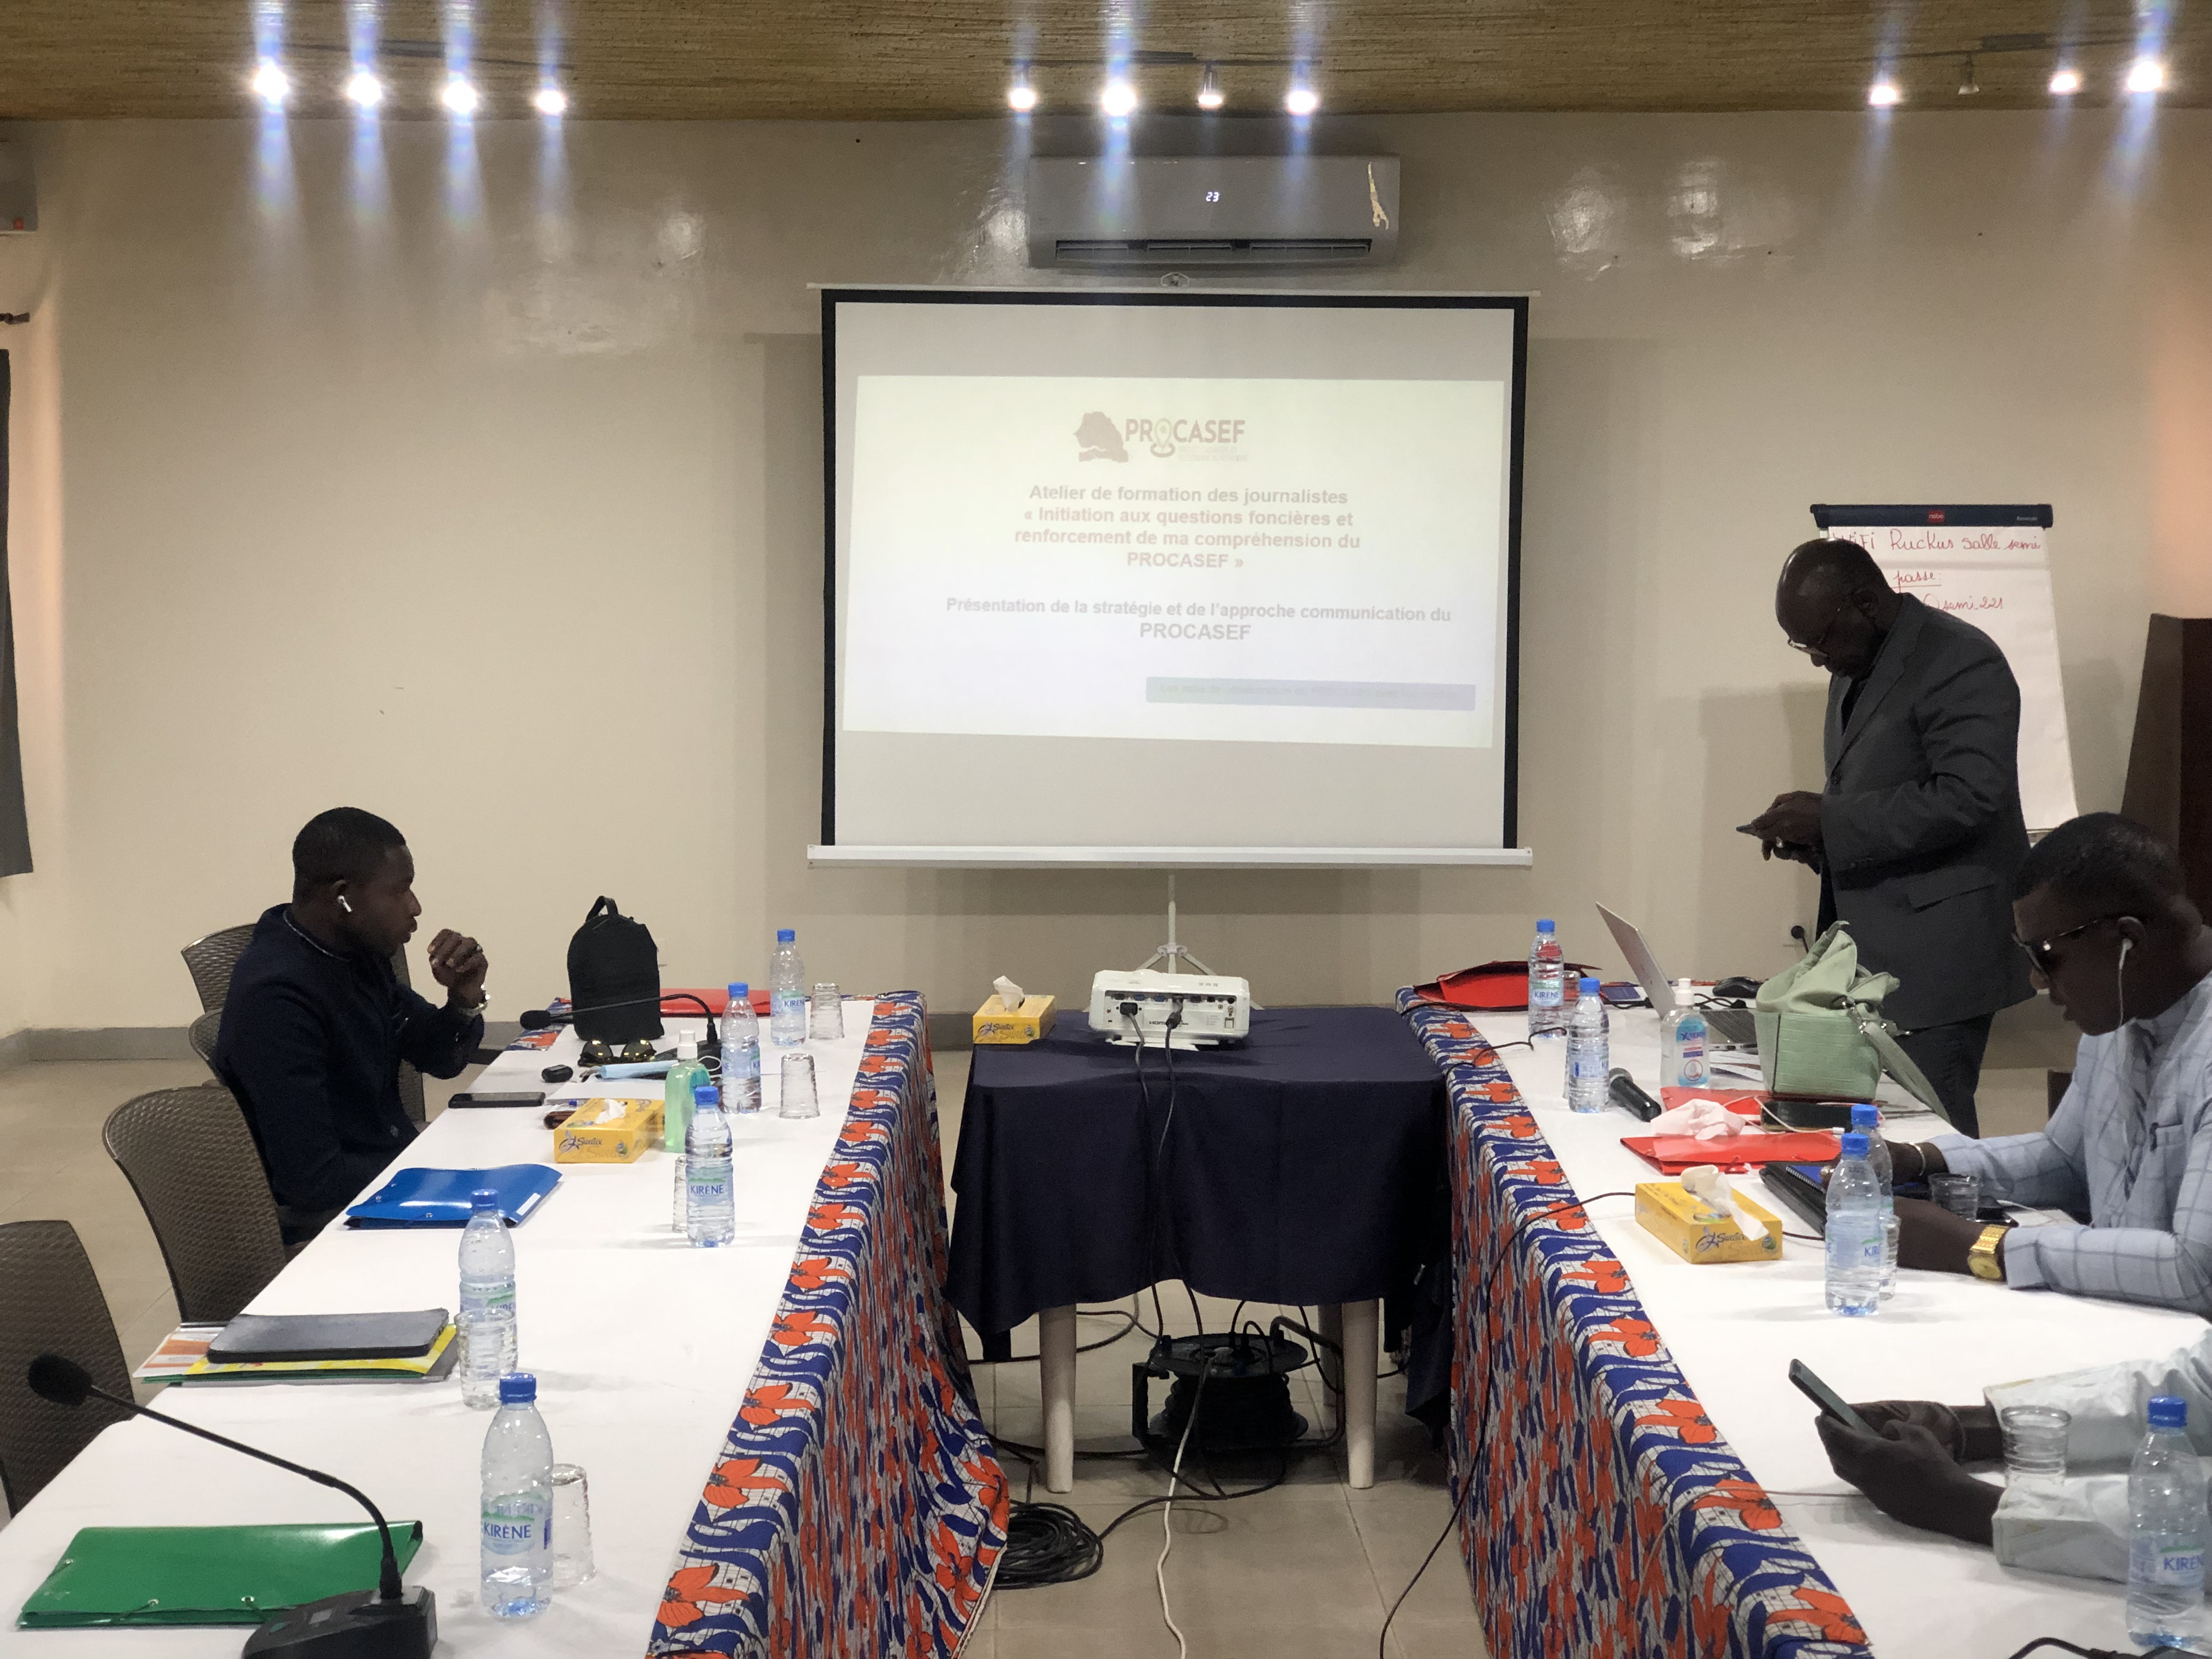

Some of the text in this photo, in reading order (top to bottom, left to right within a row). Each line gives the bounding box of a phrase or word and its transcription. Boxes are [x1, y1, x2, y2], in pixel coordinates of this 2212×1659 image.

[1206, 191, 1219, 202] 23
[1125, 418, 1245, 445] PROCASEF
[1029, 486, 1348, 506] Atelier de formation des journalistes
[1039, 507, 1114, 522] Initiation
[1120, 511, 1151, 523] aux
[1156, 510, 1243, 527] questions
[1249, 510, 1330, 526] foncières
[1336, 512, 1354, 526] et
[1015, 529, 1361, 550] renforcement de ma compréhension du
[1127, 552, 1229, 568] PROCASEF
[946, 597, 1046, 613] Présentation
[1050, 600, 1070, 613] de
[1074, 600, 1088, 614] la
[1093, 601, 1162, 618] stratégie
[1166, 602, 1182, 616] et
[1186, 602, 1206, 616] de
[1300, 606, 1426, 621] communication
[1430, 607, 1451, 622] du
[1139, 622, 1251, 640] PROCASEF
